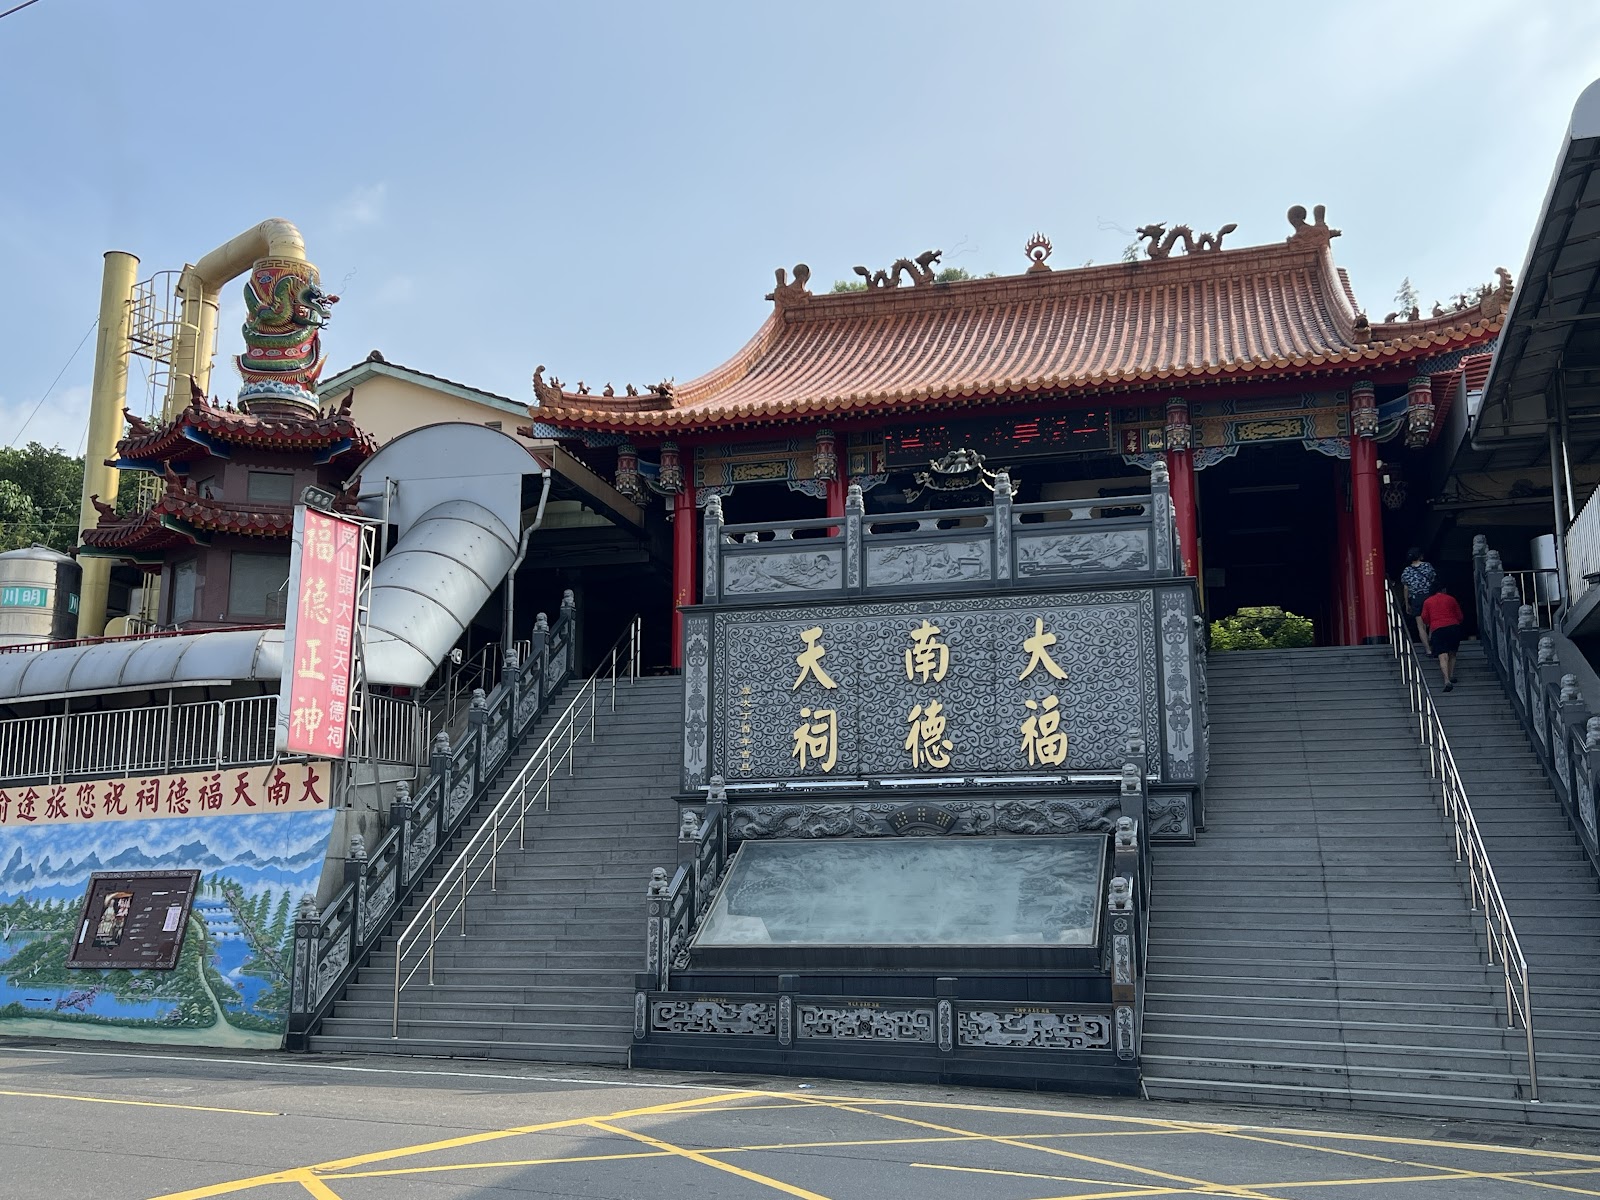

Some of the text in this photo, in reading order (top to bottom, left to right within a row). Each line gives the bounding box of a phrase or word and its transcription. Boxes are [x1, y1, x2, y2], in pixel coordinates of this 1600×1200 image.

[292, 516, 335, 746] 福德正神
[326, 525, 357, 749] 崗山頭大南天福德祠
[792, 617, 1068, 691] 大南天
[792, 695, 1068, 773] 福德祠
